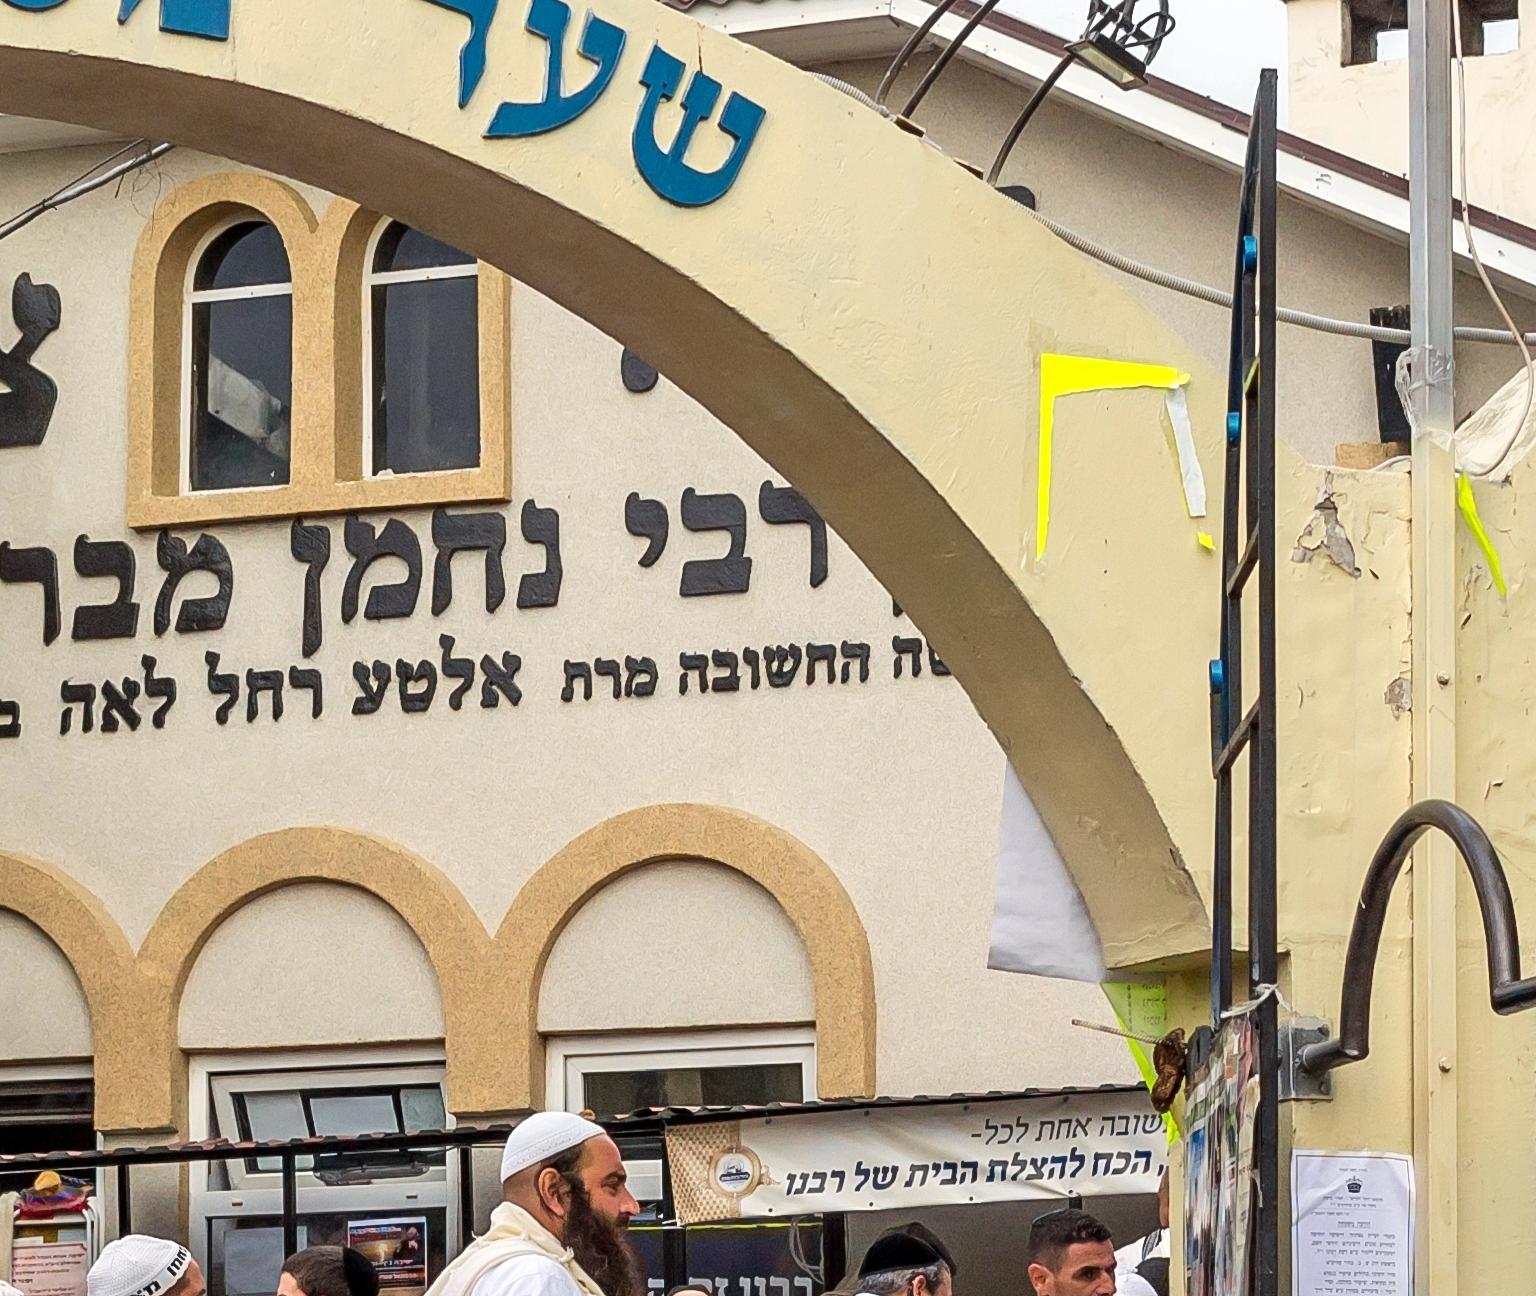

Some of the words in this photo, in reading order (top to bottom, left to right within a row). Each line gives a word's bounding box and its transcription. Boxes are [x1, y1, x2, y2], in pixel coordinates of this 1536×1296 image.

[625, 480, 830, 597] רבי
[291, 498, 563, 658] נחמן
[205, 649, 324, 726] רחל
[351, 633, 523, 716] אלטע
[560, 655, 659, 704] מרת
[679, 638, 871, 696] החשובה
[60, 653, 177, 736] לאה
[1035, 1117, 1093, 1142] אחת
[1099, 1113, 1167, 1137] שובה
[785, 1169, 846, 1196] רבנו
[854, 1160, 900, 1193] של
[904, 1159, 980, 1188] הבית
[986, 1147, 1086, 1183] להצלת
[1092, 1148, 1154, 1177] הכח
